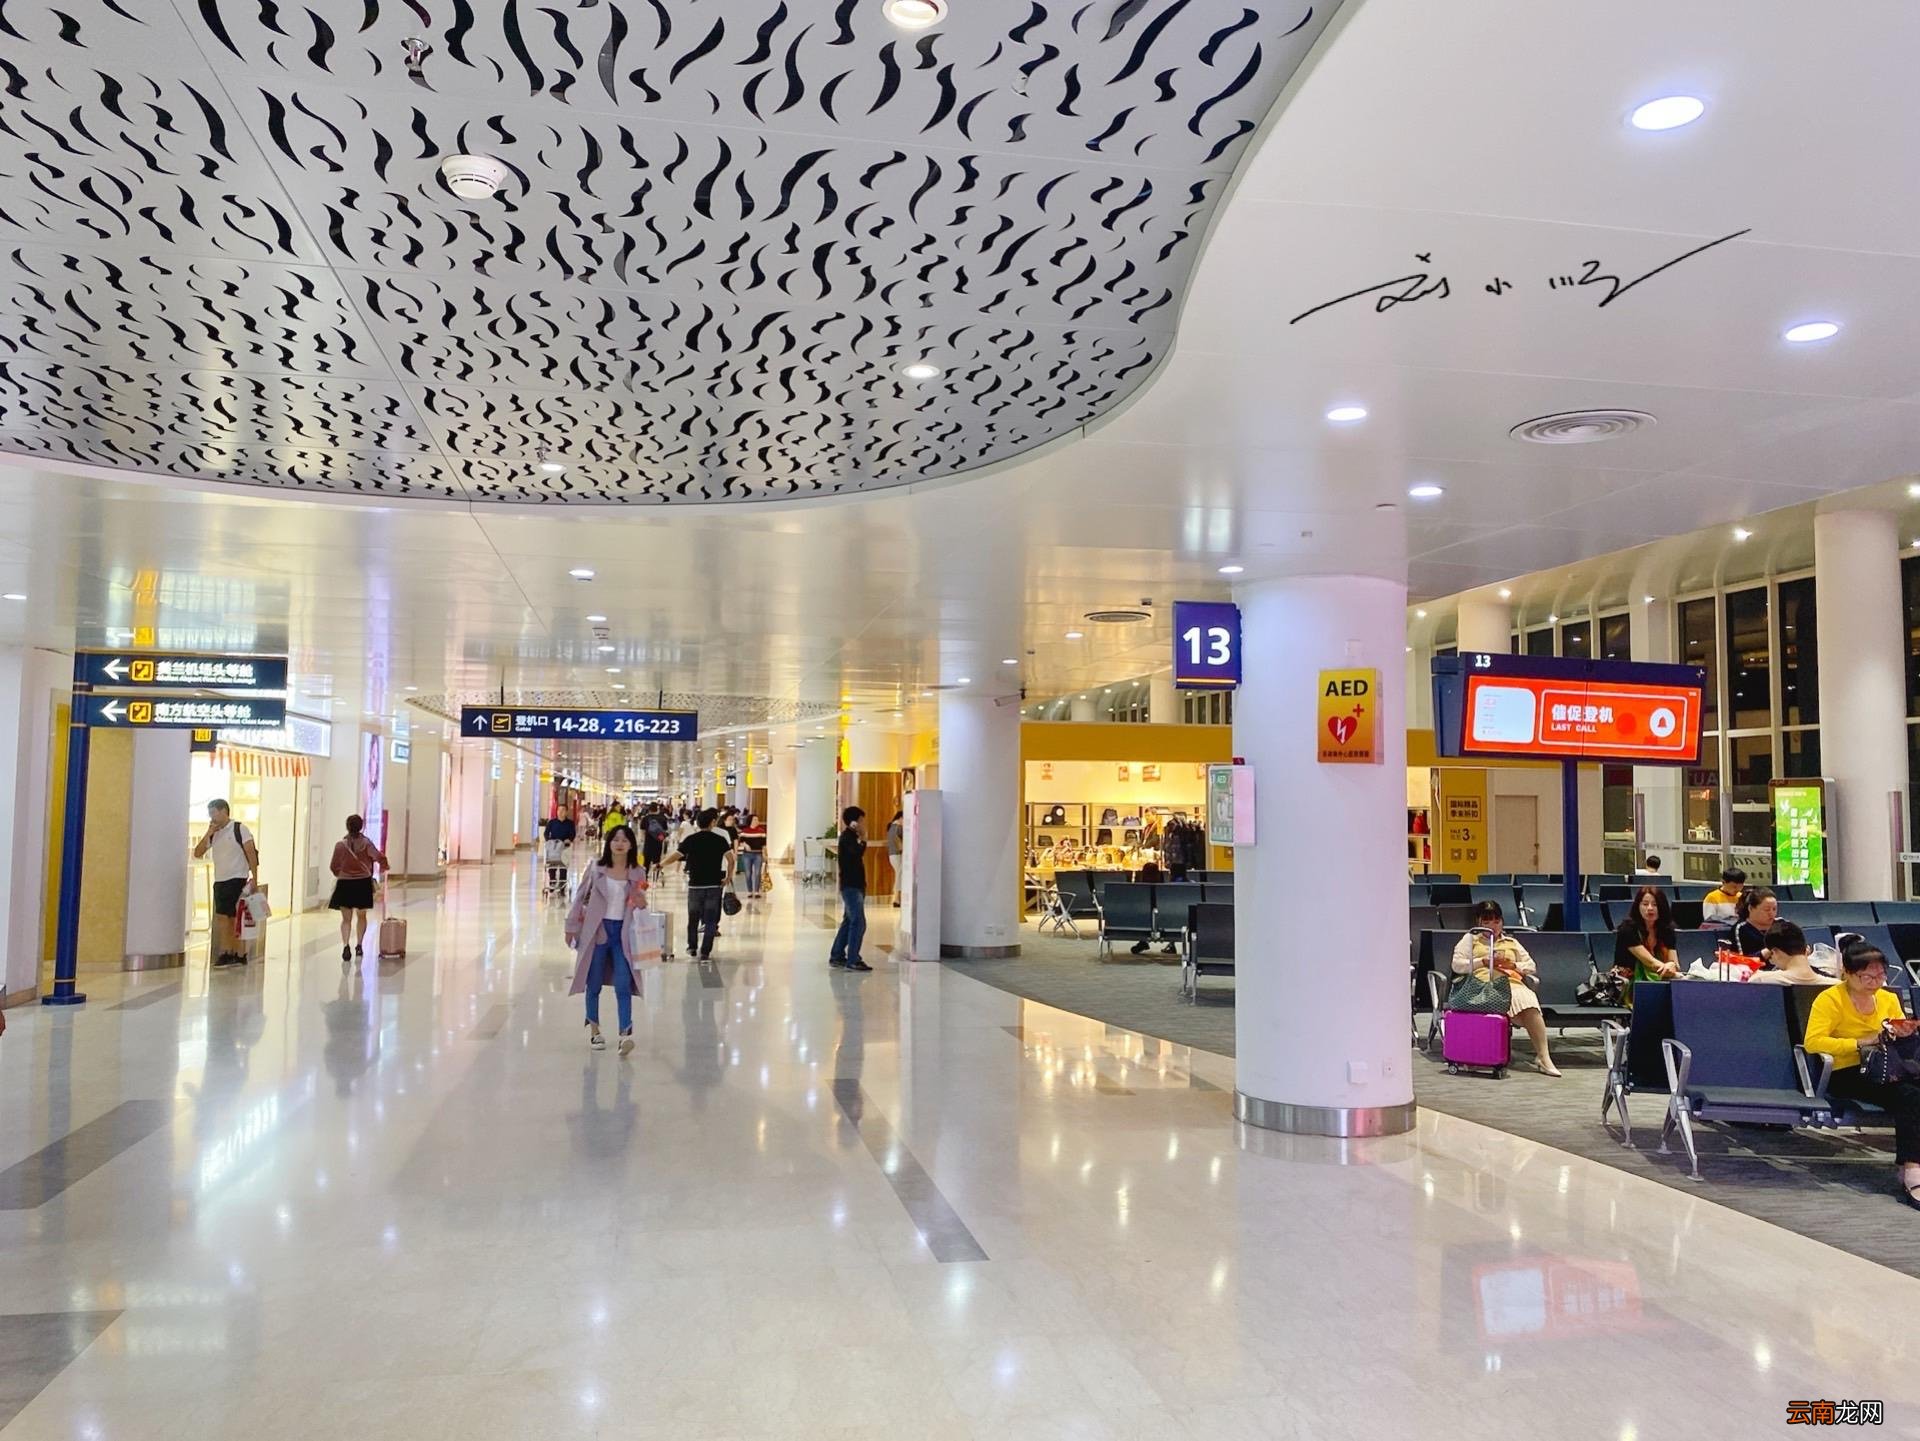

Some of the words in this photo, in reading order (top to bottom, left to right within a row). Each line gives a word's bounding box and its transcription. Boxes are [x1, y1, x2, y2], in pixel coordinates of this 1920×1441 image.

[1182, 627, 1231, 666] 13
[1474, 654, 1491, 668] 13
[1325, 679, 1368, 697] AED
[515, 715, 548, 727] 登机口
[1551, 704, 1614, 723] 催促登机
[614, 718, 680, 734] 216-223
[1551, 723, 1572, 733] LAST
[1575, 724, 1597, 733] CALL
[1462, 828, 1471, 842] 3
